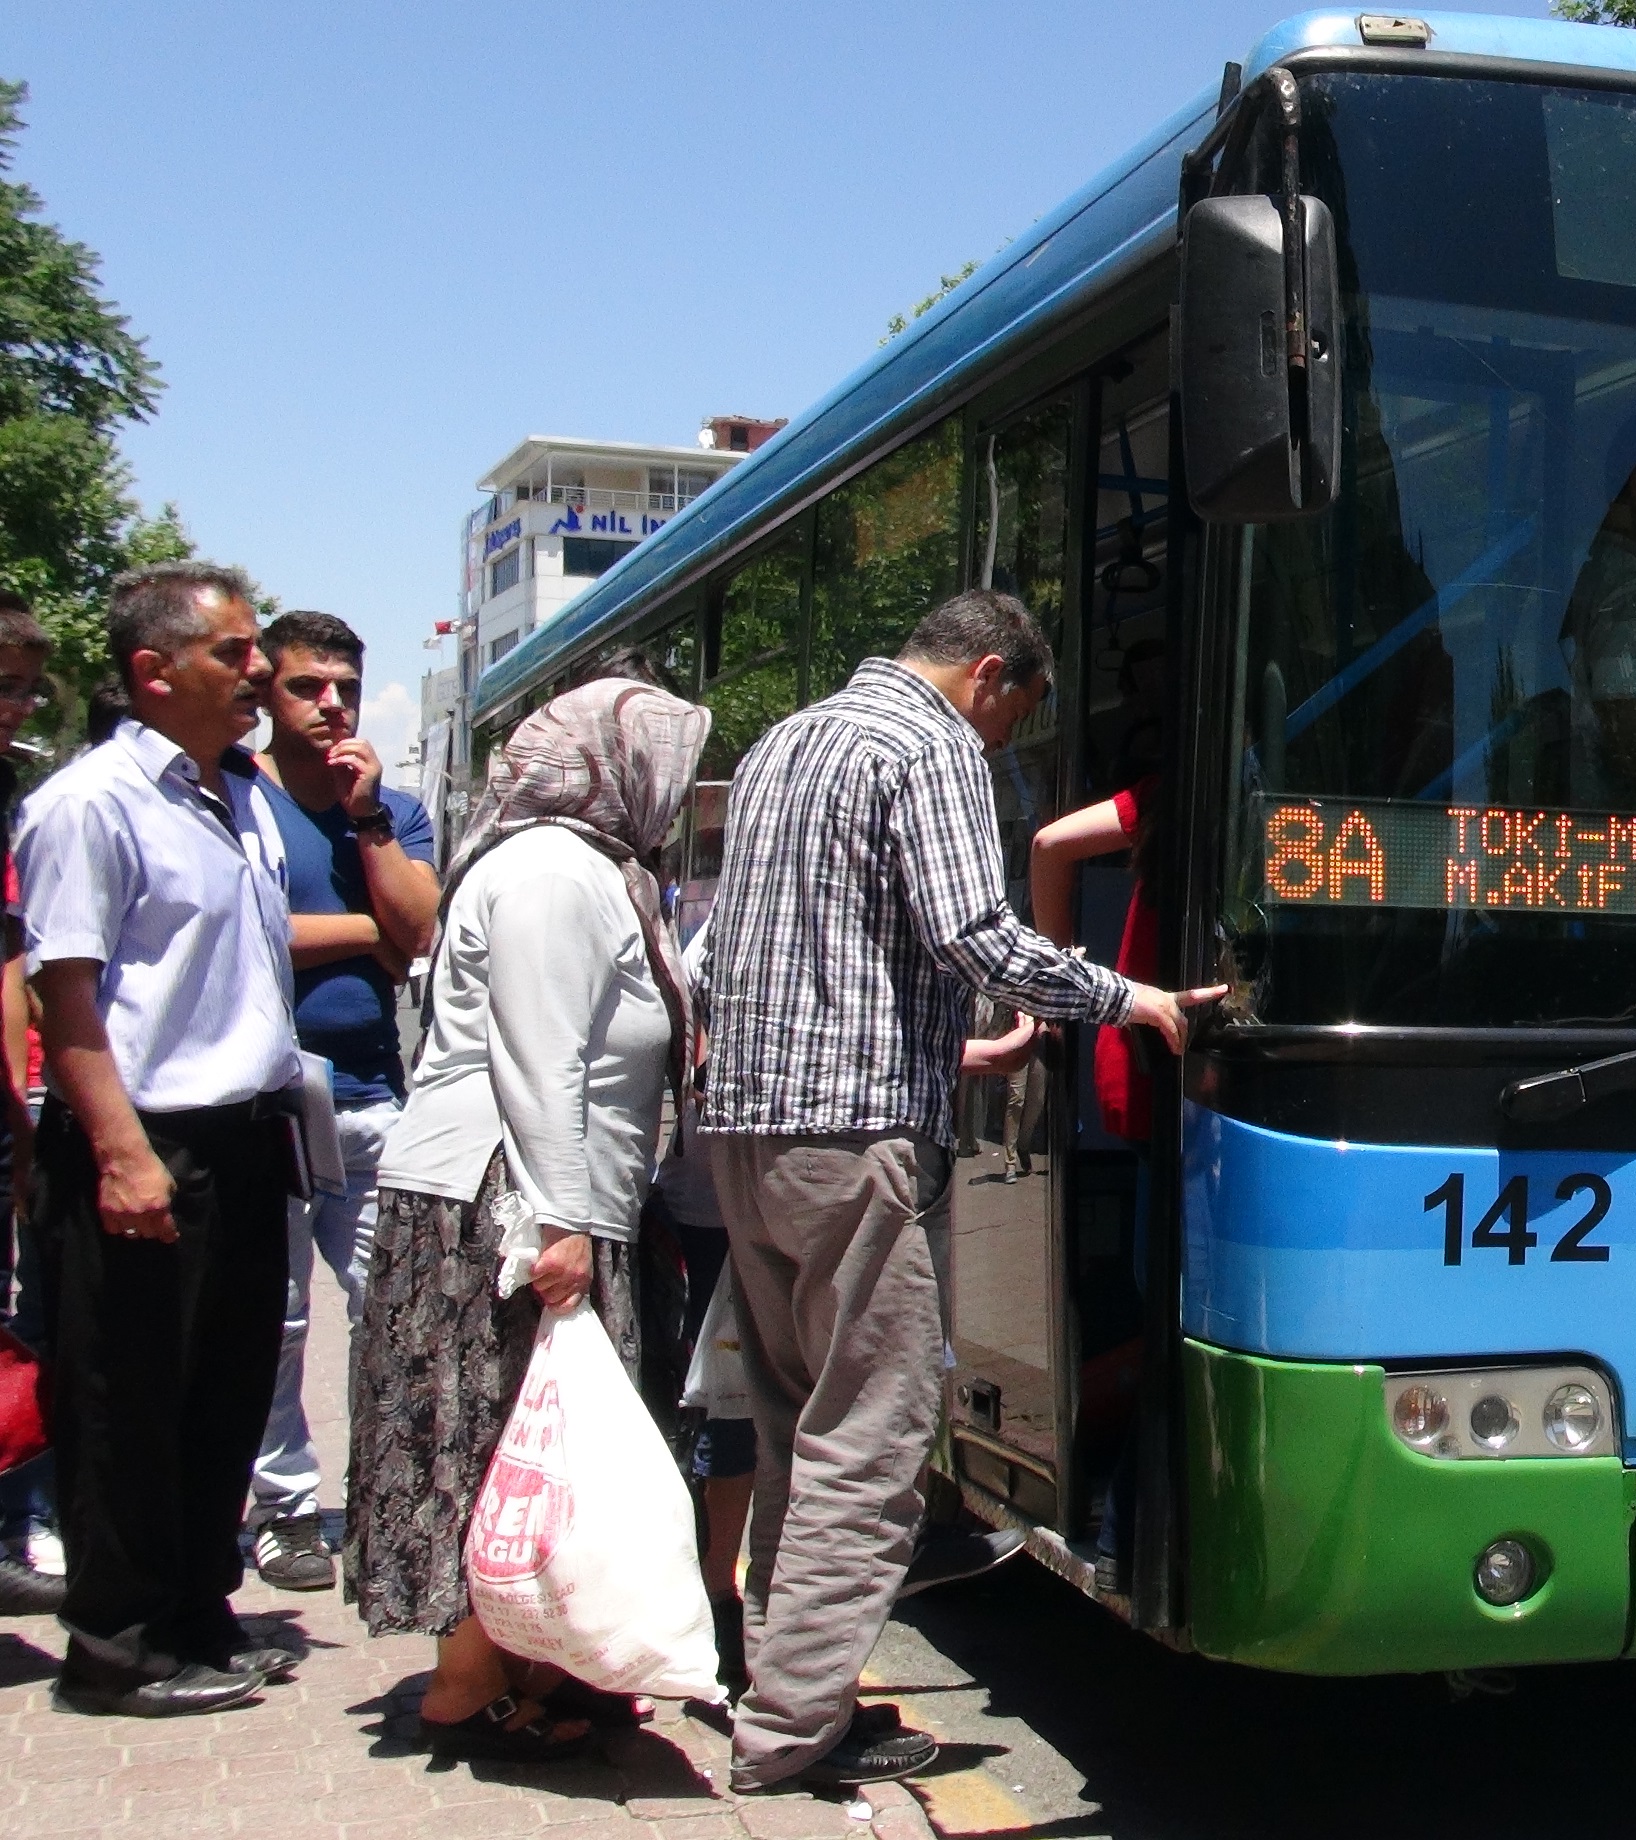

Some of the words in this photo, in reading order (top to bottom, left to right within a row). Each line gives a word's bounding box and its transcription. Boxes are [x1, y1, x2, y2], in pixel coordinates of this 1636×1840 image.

[591, 510, 632, 533] NİL
[1266, 806, 1385, 902] 8A
[1423, 1172, 1613, 1266] 142
